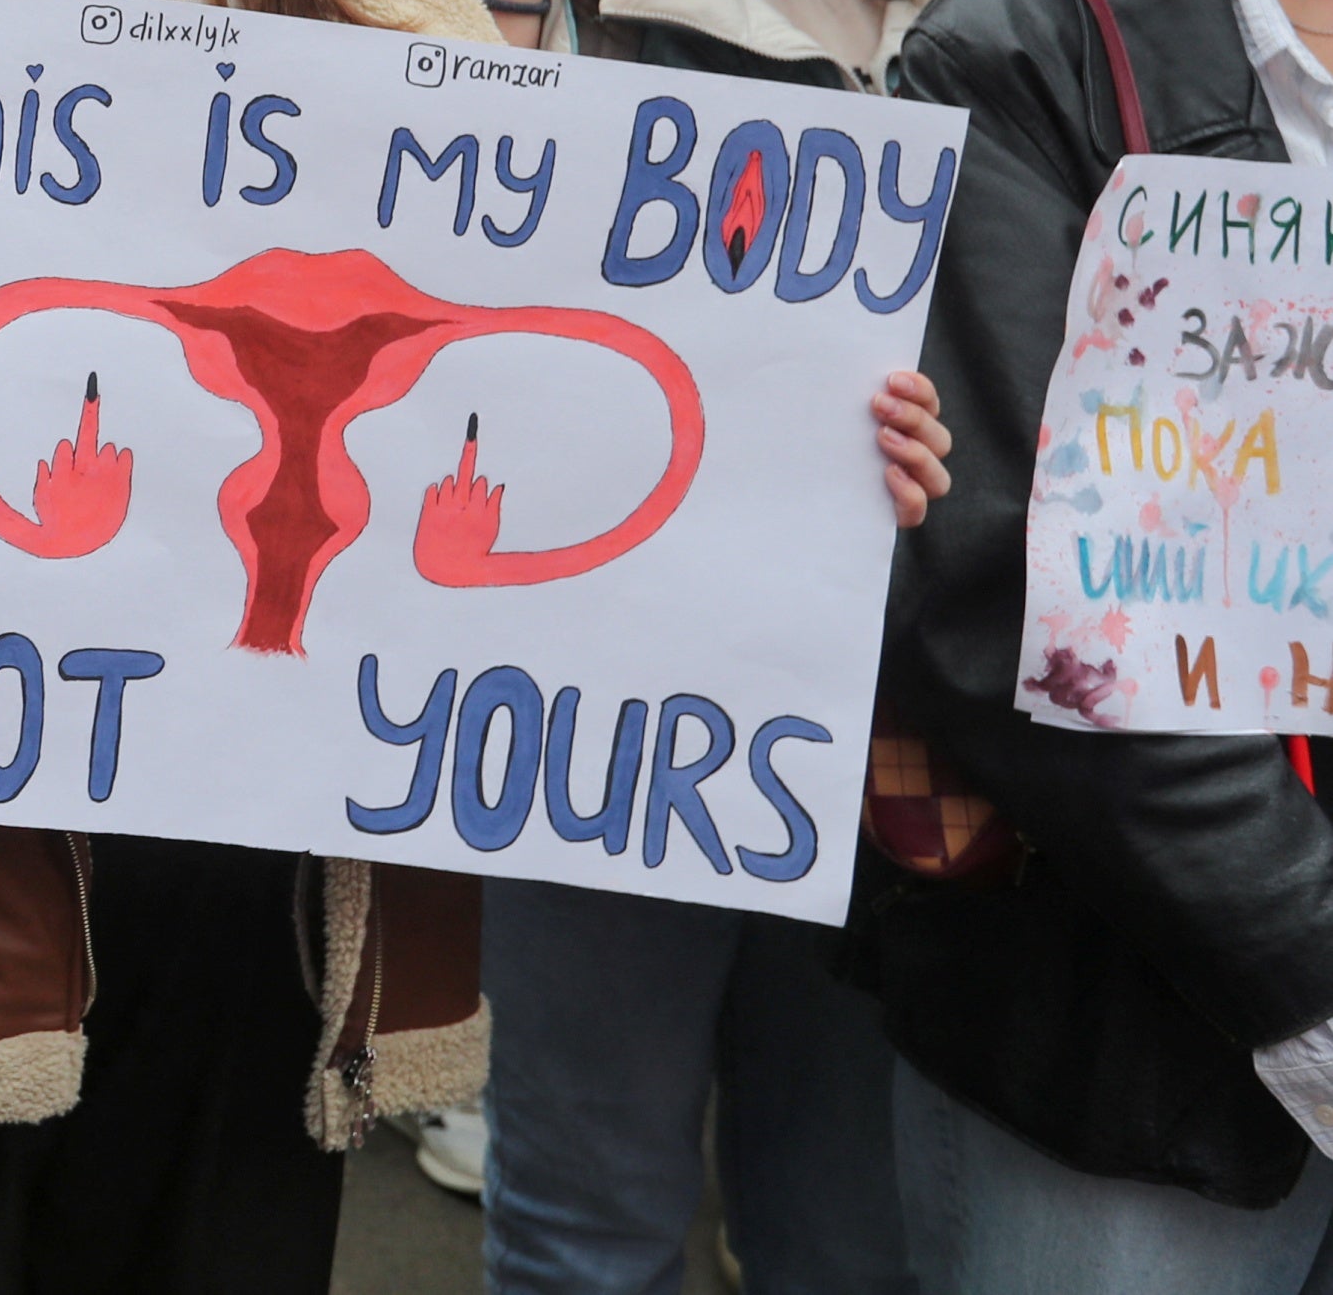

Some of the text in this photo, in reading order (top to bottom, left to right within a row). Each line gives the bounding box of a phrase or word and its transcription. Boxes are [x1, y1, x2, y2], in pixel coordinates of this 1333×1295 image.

[202, 62, 301, 206] is
[602, 96, 955, 315] BODY
[1096, 405, 1281, 494] ПОКА
[346, 655, 833, 882] YOURS
